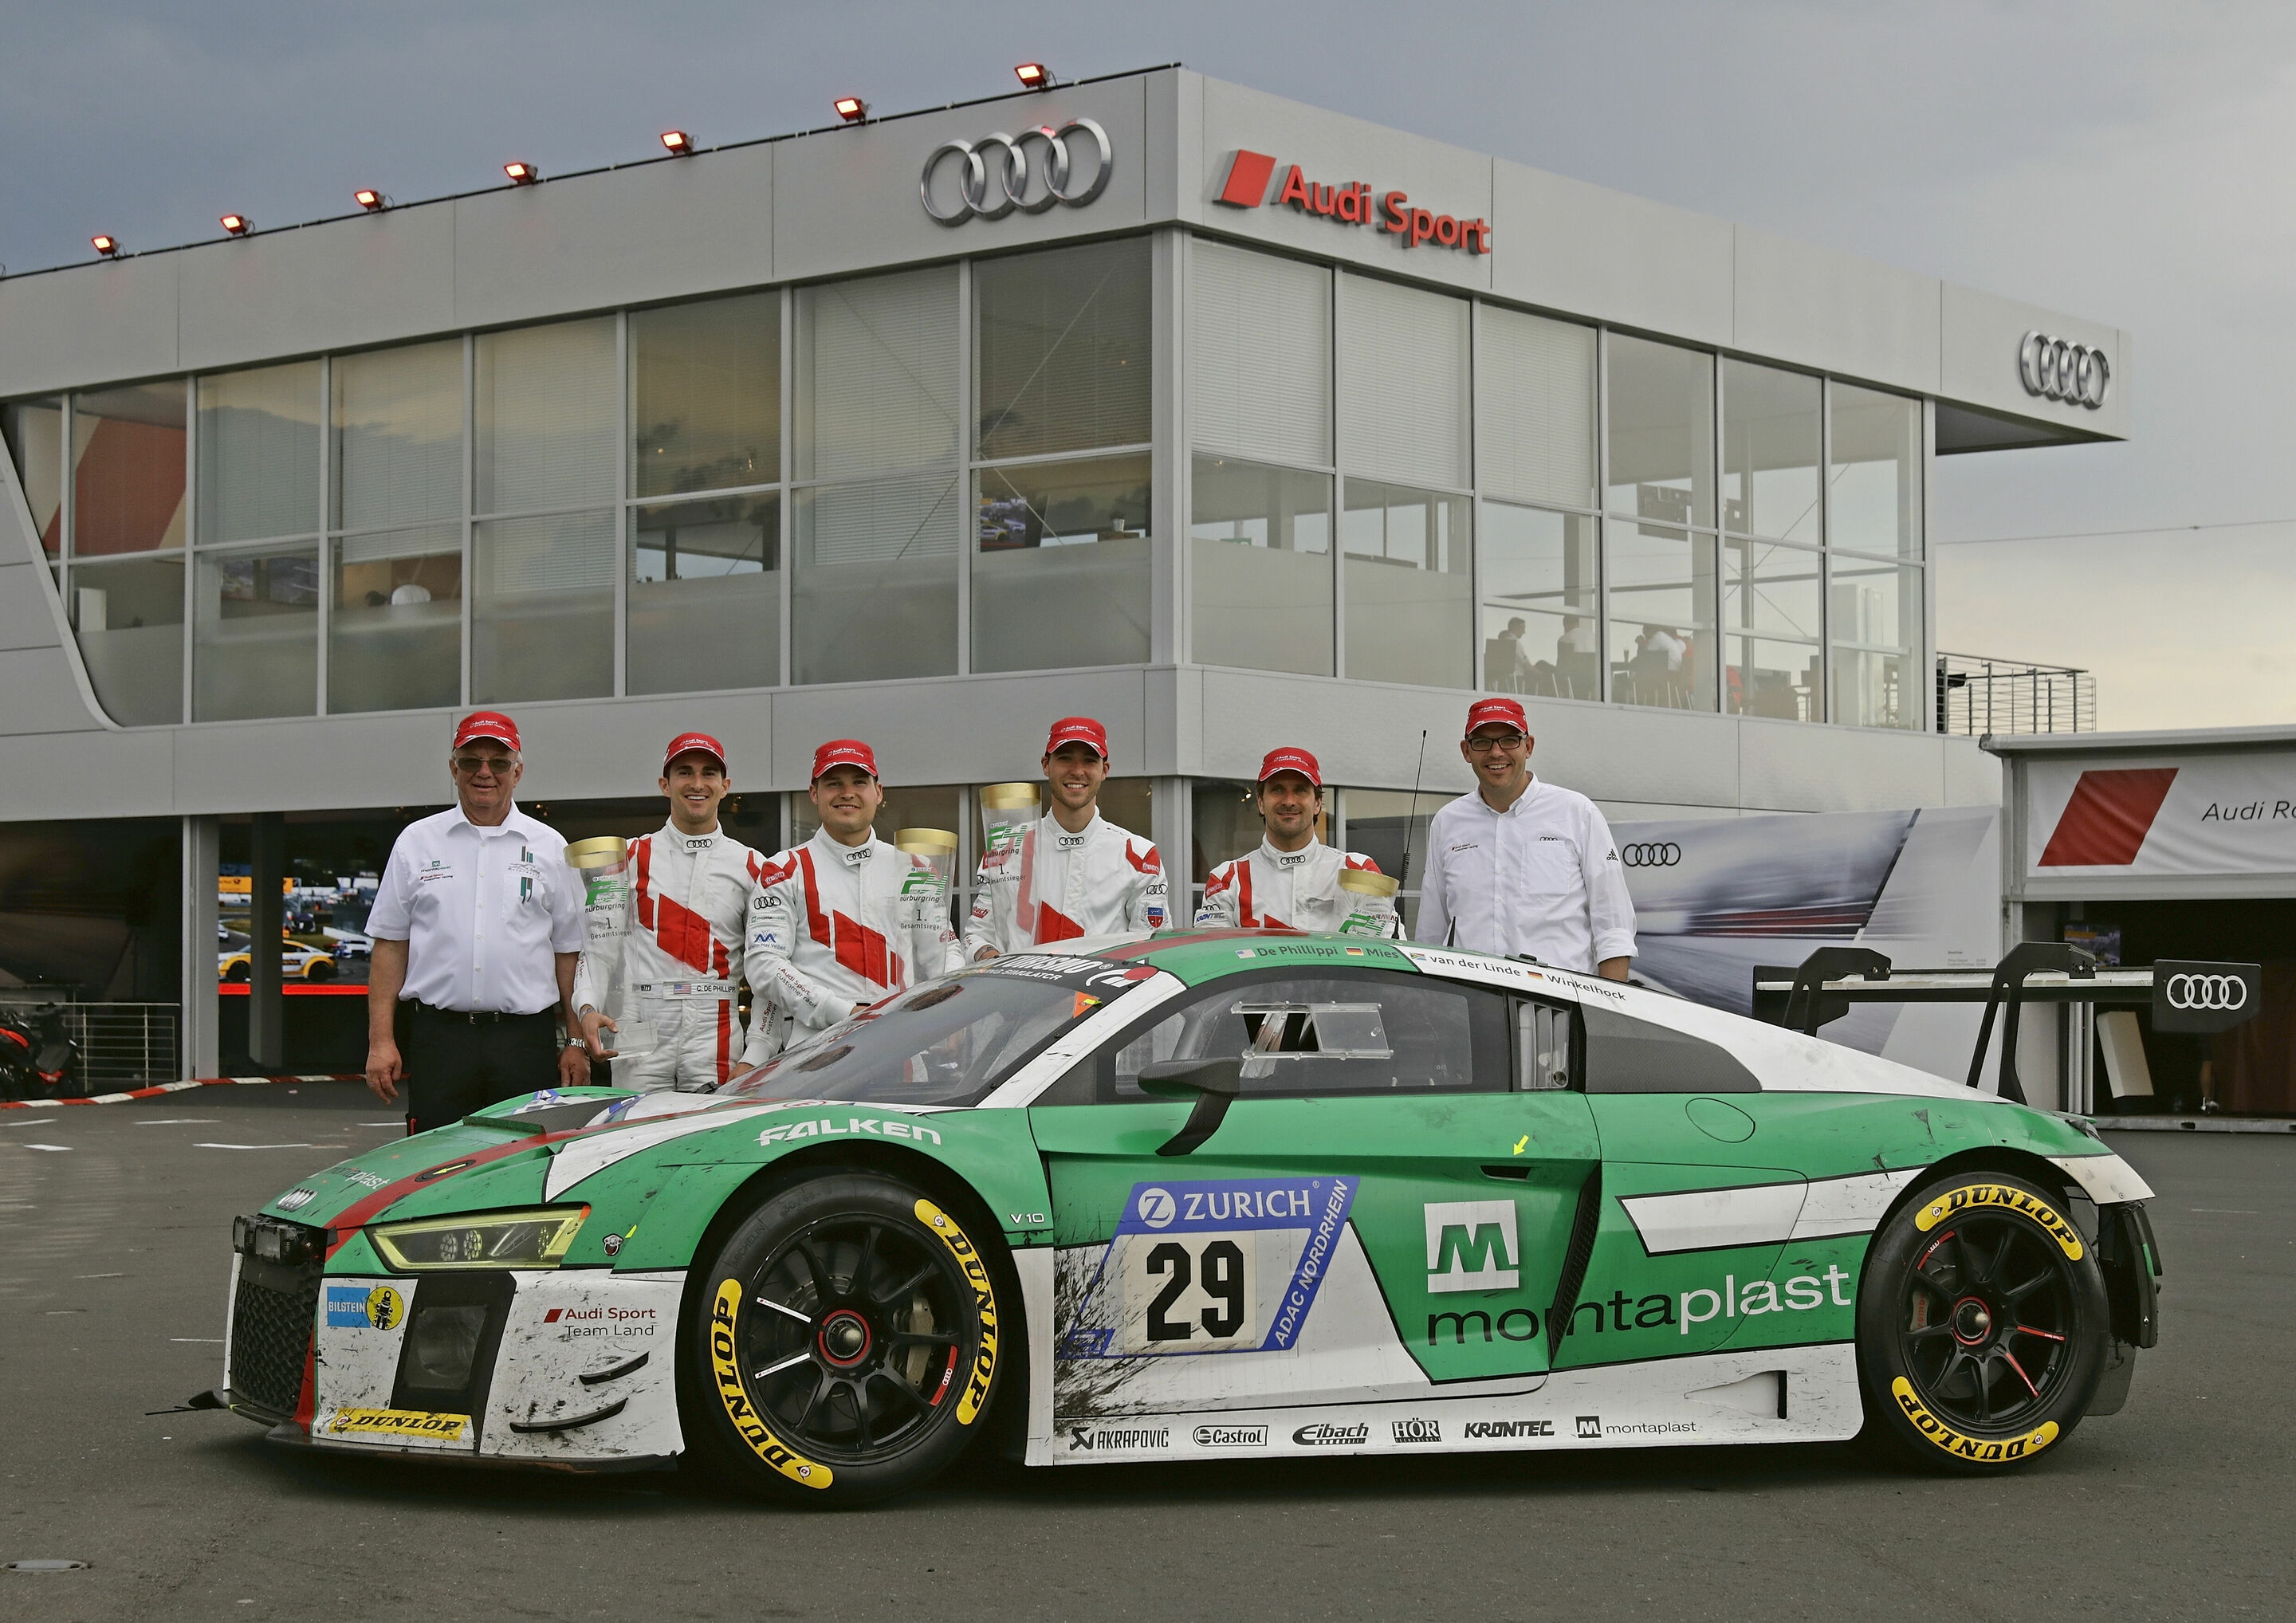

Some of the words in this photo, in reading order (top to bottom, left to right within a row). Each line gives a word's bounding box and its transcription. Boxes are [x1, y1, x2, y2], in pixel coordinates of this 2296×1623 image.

[1280, 163, 1372, 225] Audi
[1384, 191, 1491, 254] Sport
[2201, 801, 2265, 822] Audi
[605, 918, 618, 929] 1.
[916, 909, 927, 922] 1.
[1256, 947, 1277, 957] De
[1279, 945, 1339, 957] Phillippi
[1366, 946, 1399, 959] Mies
[776, 973, 803, 997] customer
[780, 968, 796, 982] Audi
[793, 980, 811, 996] Sport
[1429, 955, 1454, 965] van
[1459, 958, 1480, 970] der
[1484, 961, 1522, 977] Linde
[1546, 973, 1627, 1001] Winkelhock
[753, 1118, 942, 1146] FALKEN
[1183, 1189, 1311, 1221] ZURICH
[1946, 1185, 2076, 1246] DUNLOP
[1298, 1179, 1349, 1291] NORDRHEIN
[1146, 1240, 1244, 1341] 29
[328, 1301, 365, 1314] BILSTEIN
[564, 1307, 603, 1320] Audi
[607, 1307, 656, 1322] Sport
[1275, 1291, 1304, 1348] ADAC
[564, 1324, 608, 1337] Team
[614, 1324, 655, 1337] Land
[944, 1231, 997, 1411] DUNLOP
[714, 1296, 796, 1470] DUNLOP
[352, 1416, 462, 1432] DUNLOP
[1213, 1427, 1263, 1444] Castrol
[1292, 1422, 1370, 1446] Eibach
[1393, 1417, 1441, 1439] HÖR
[1464, 1421, 1555, 1439] KRONTEC
[1606, 1421, 1697, 1435] montaplast
[1897, 1393, 2029, 1460] DUNLOP
